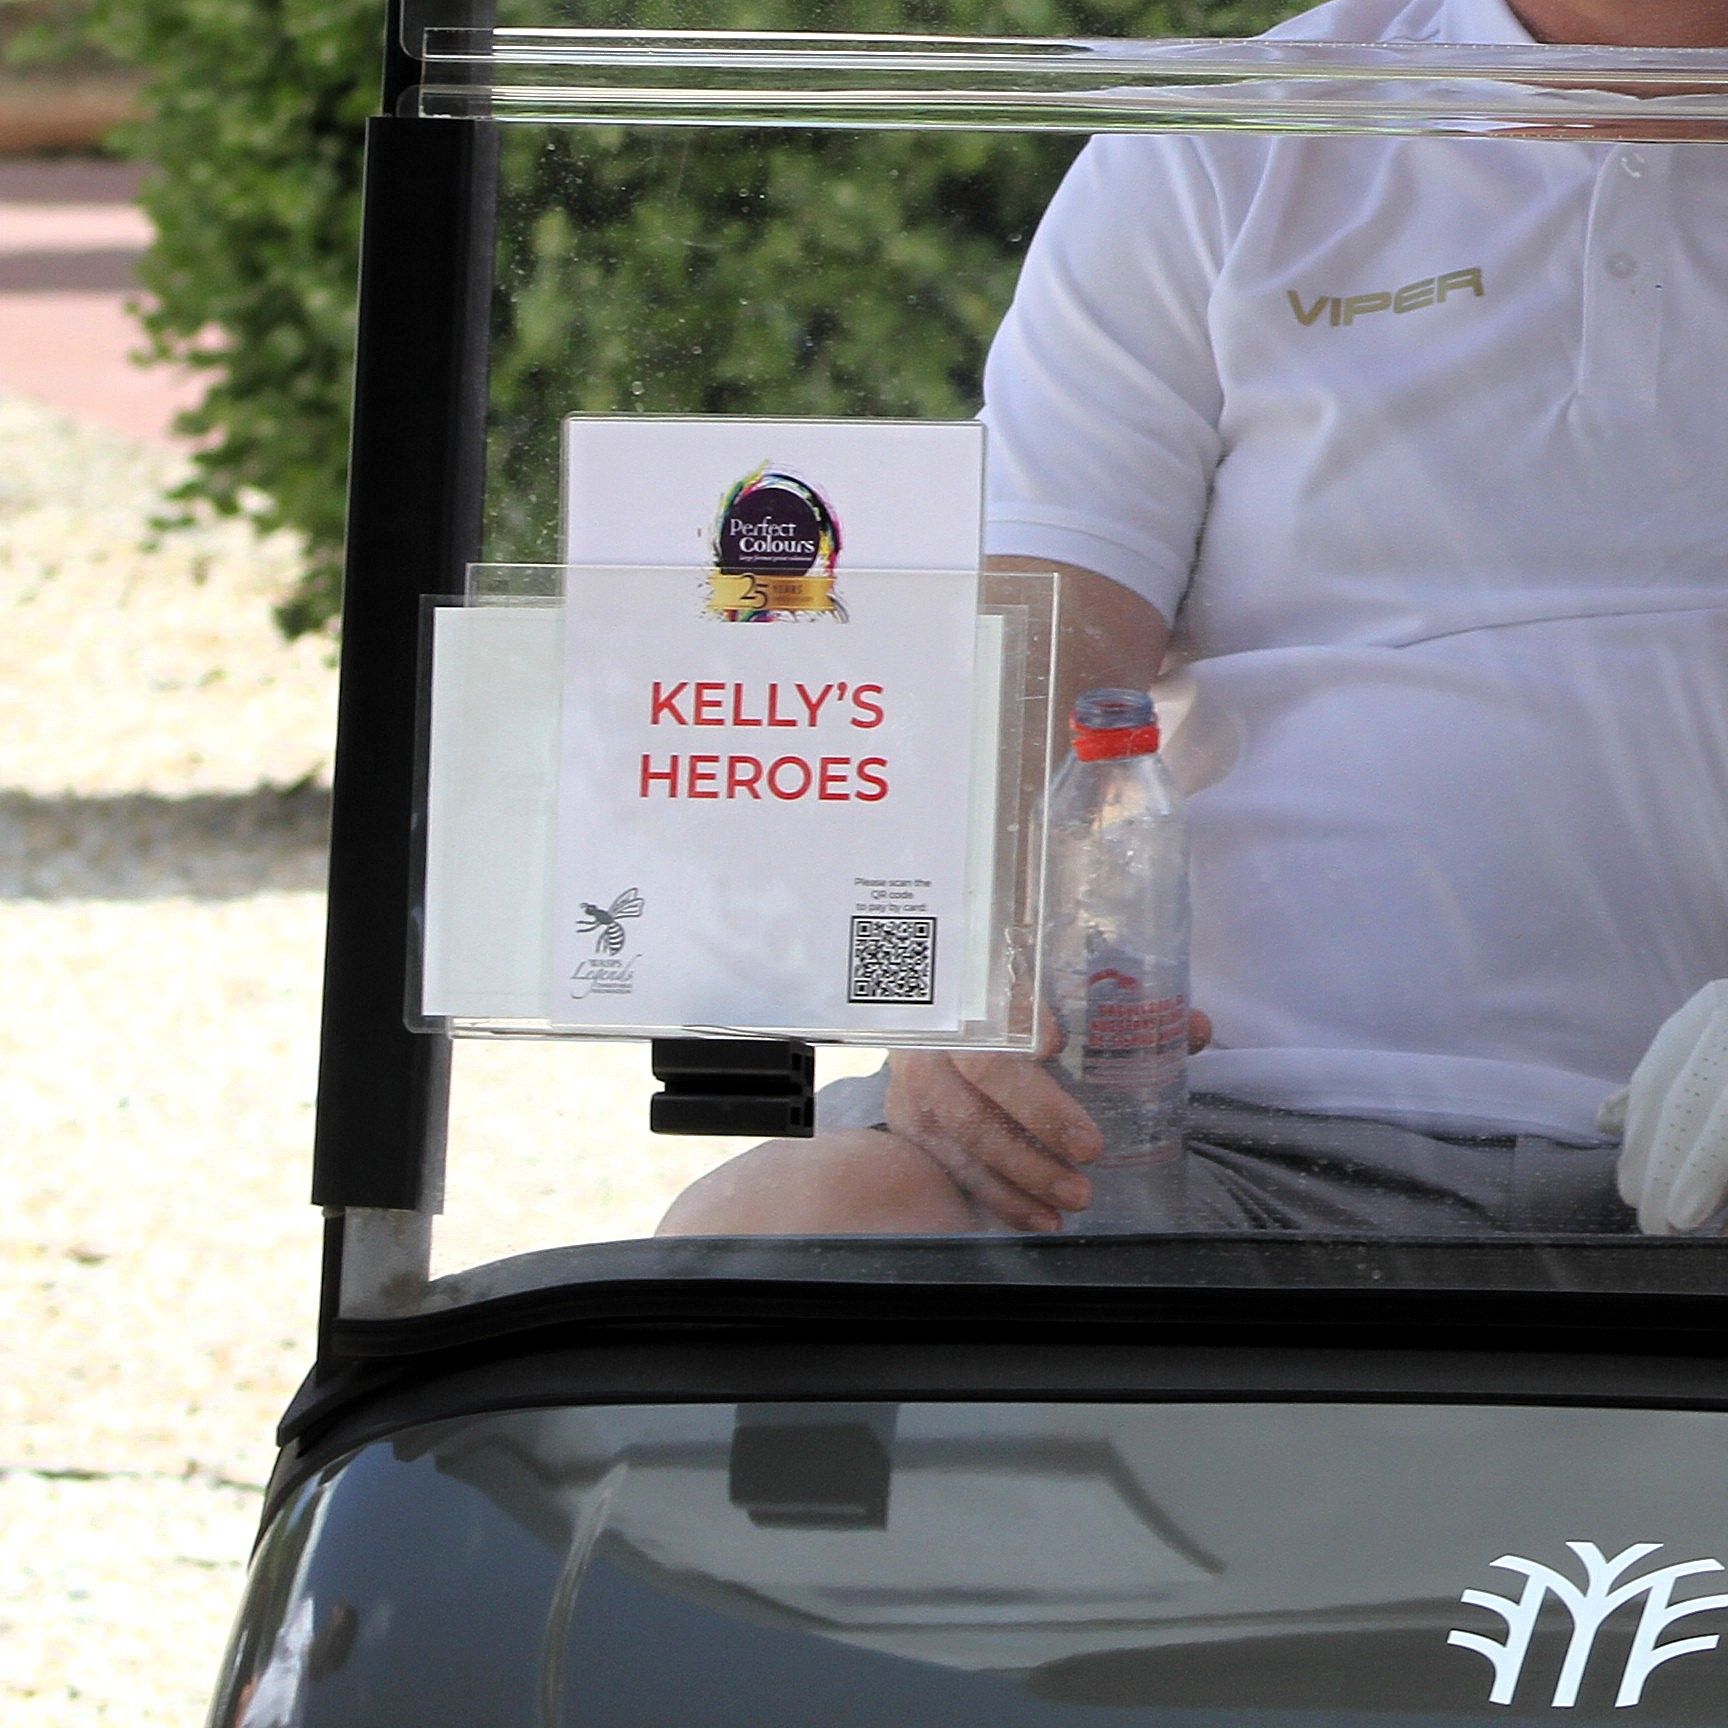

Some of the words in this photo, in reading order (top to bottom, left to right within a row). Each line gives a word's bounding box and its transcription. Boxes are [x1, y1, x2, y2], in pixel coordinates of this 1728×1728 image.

[1286, 266, 1485, 328] VIPER
[729, 516, 797, 538] Perfect
[738, 533, 816, 554] Colours
[740, 573, 769, 609] 25
[650, 680, 886, 730] KELLY'S
[639, 753, 890, 803] HEROES
